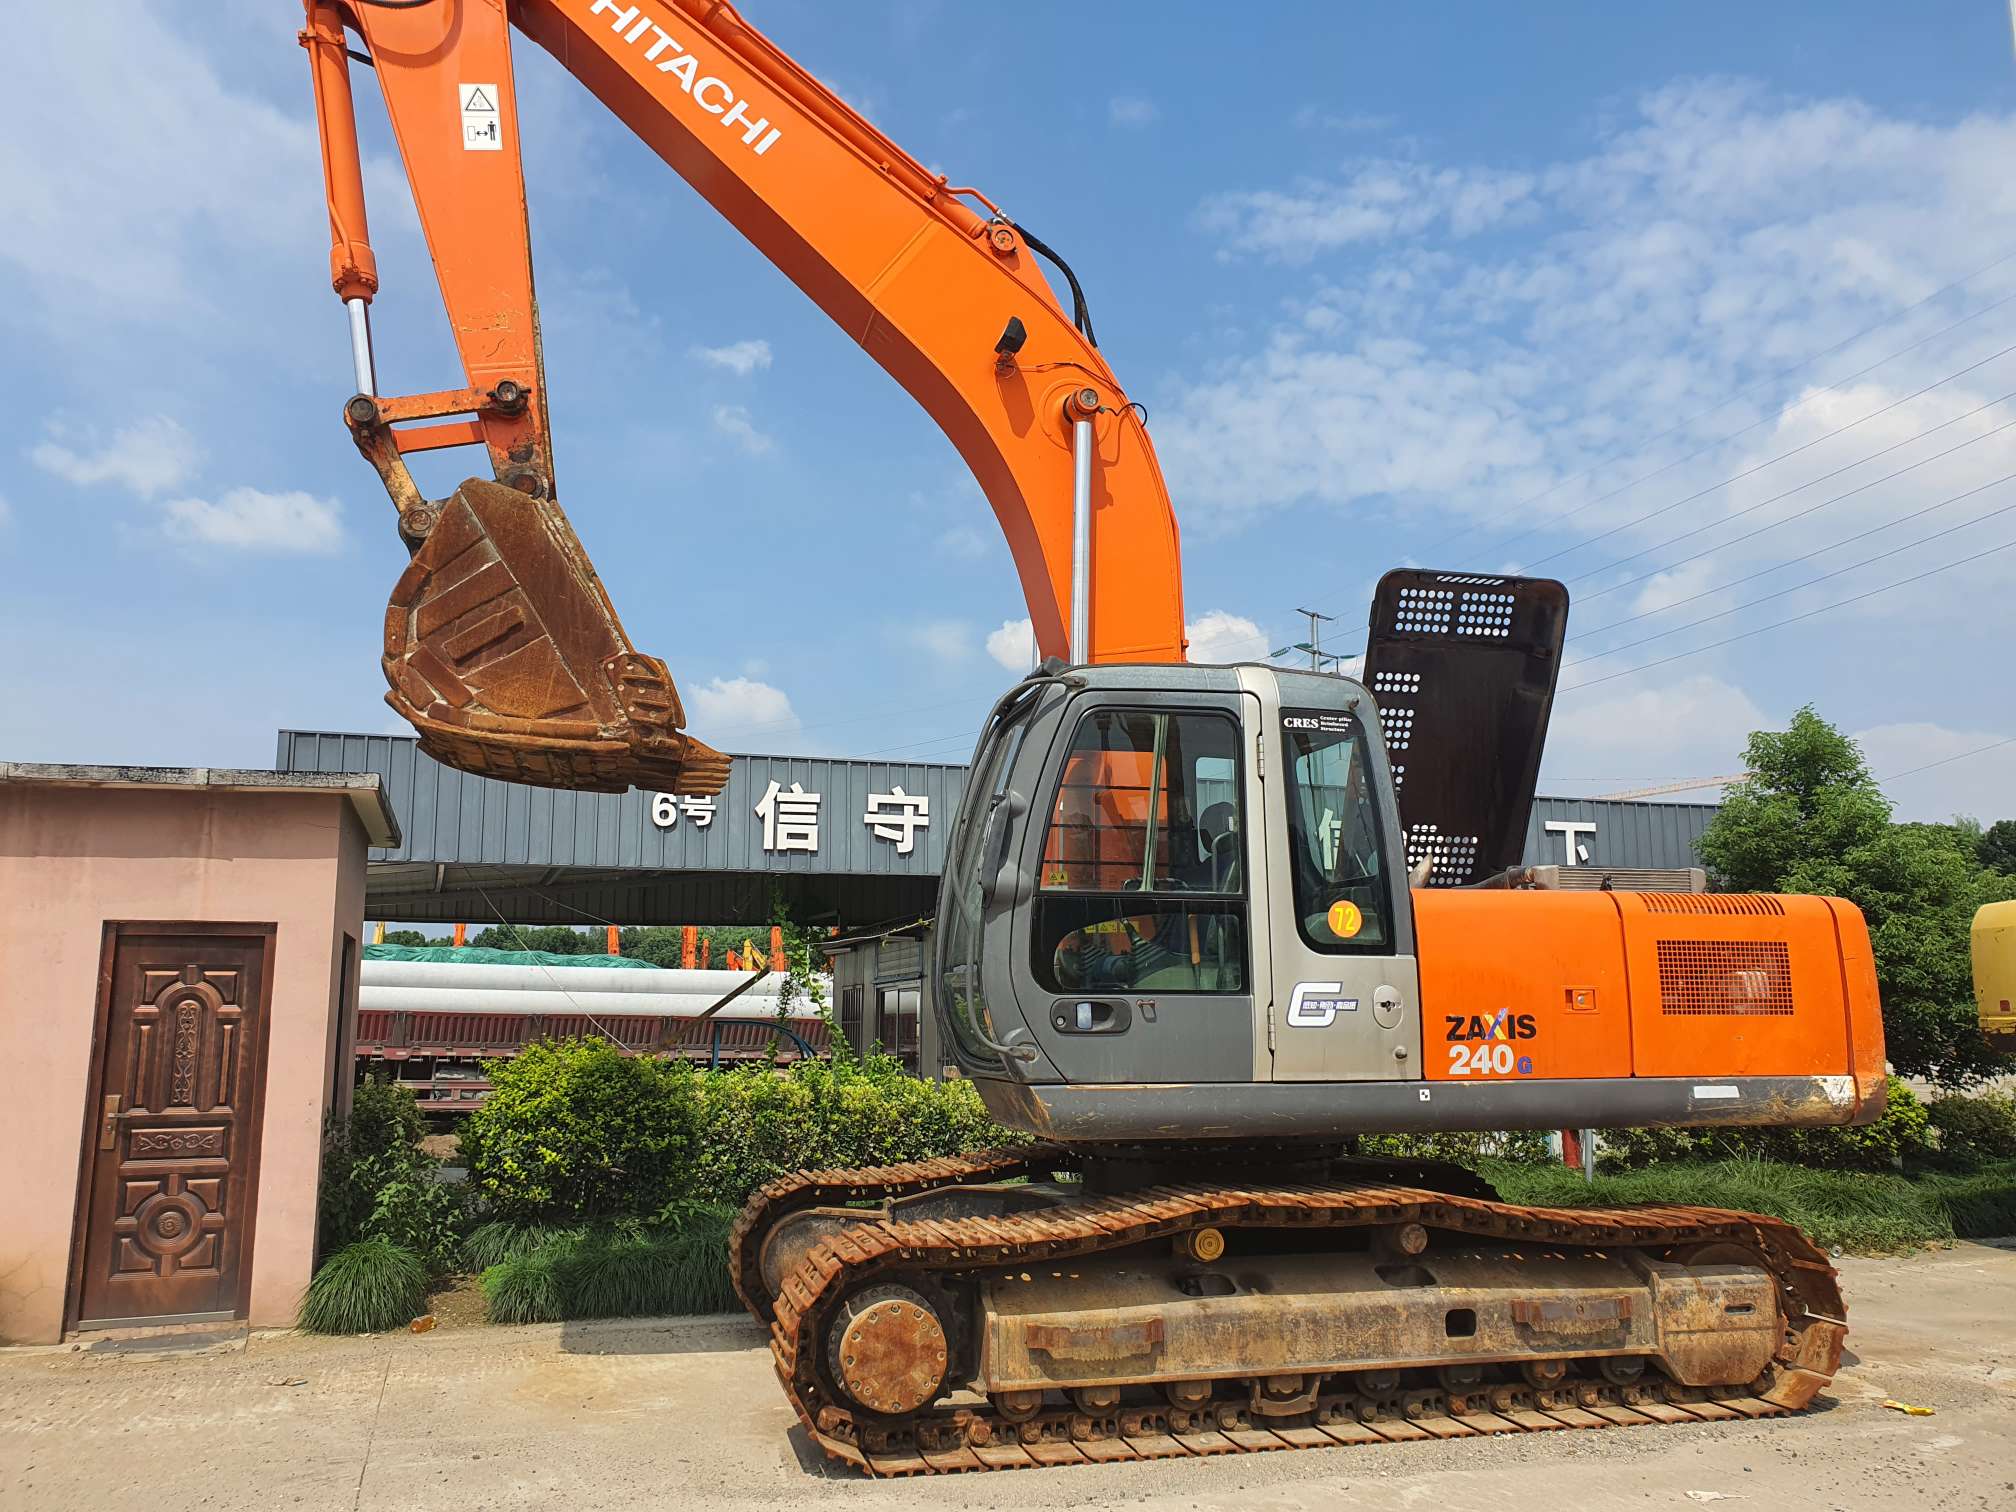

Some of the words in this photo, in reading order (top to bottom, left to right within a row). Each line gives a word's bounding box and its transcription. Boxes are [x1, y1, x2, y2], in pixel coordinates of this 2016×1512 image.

[590, 0, 782, 156] HITACHI
[1283, 717, 1319, 729] CRES
[1334, 907, 1356, 932] 72
[1445, 1008, 1537, 1041] ZAXIS
[1448, 1044, 1515, 1075] 240
